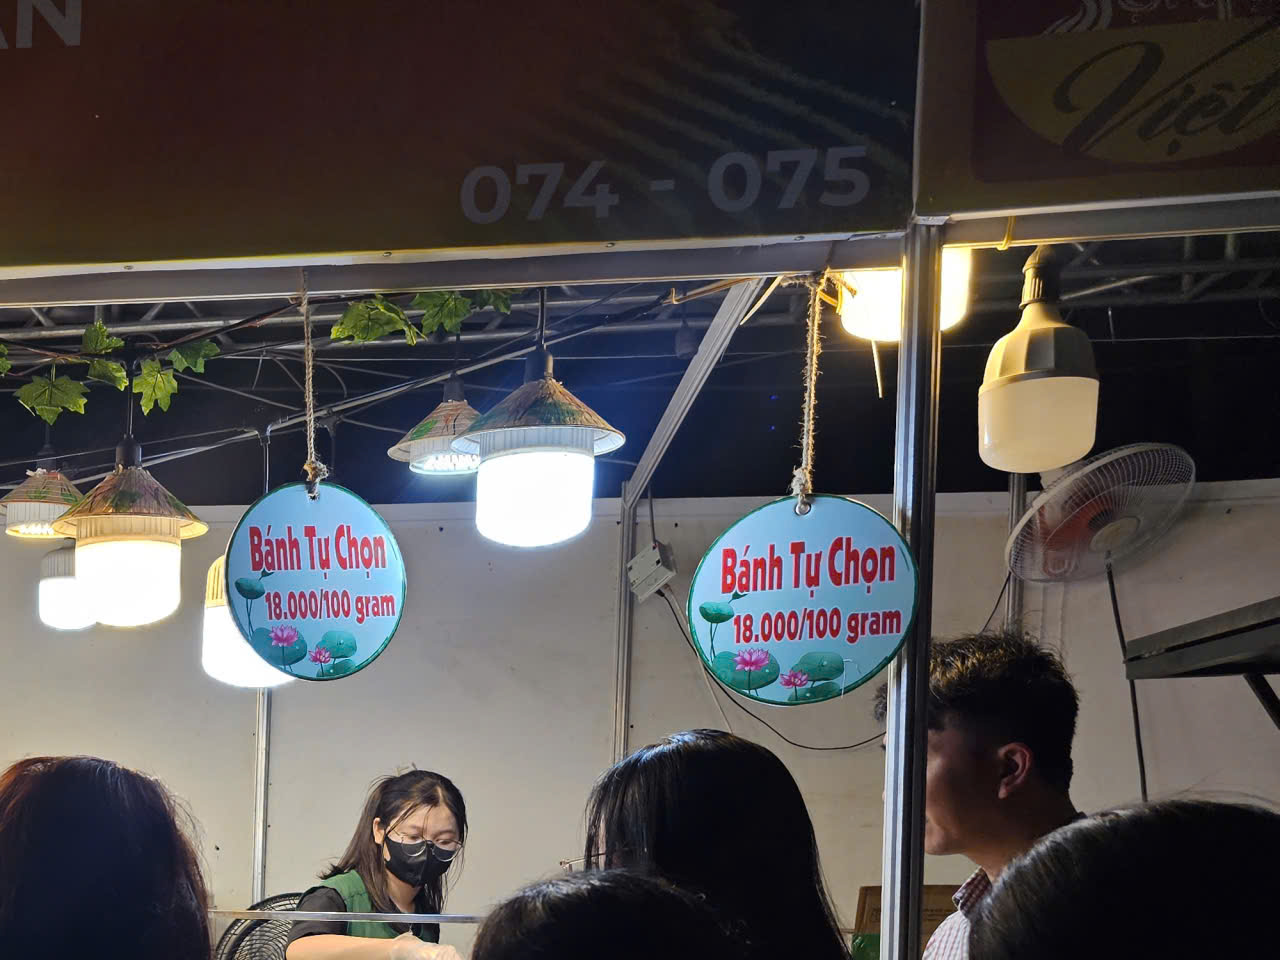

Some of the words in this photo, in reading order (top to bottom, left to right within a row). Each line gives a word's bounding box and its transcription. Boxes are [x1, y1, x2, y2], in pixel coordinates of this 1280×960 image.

[459, 159, 620, 225] 074
[707, 145, 872, 213] 075
[248, 524, 302, 572] Bánh
[303, 525, 330, 580] Tự
[334, 524, 387, 579] Chọn
[721, 543, 783, 594] Bánh
[789, 541, 822, 598] Tự
[827, 536, 896, 594] Chọn
[264, 588, 352, 621] 18.000/100
[354, 594, 396, 624] gram
[733, 607, 842, 644] 18.000/100
[845, 609, 902, 644] gram
